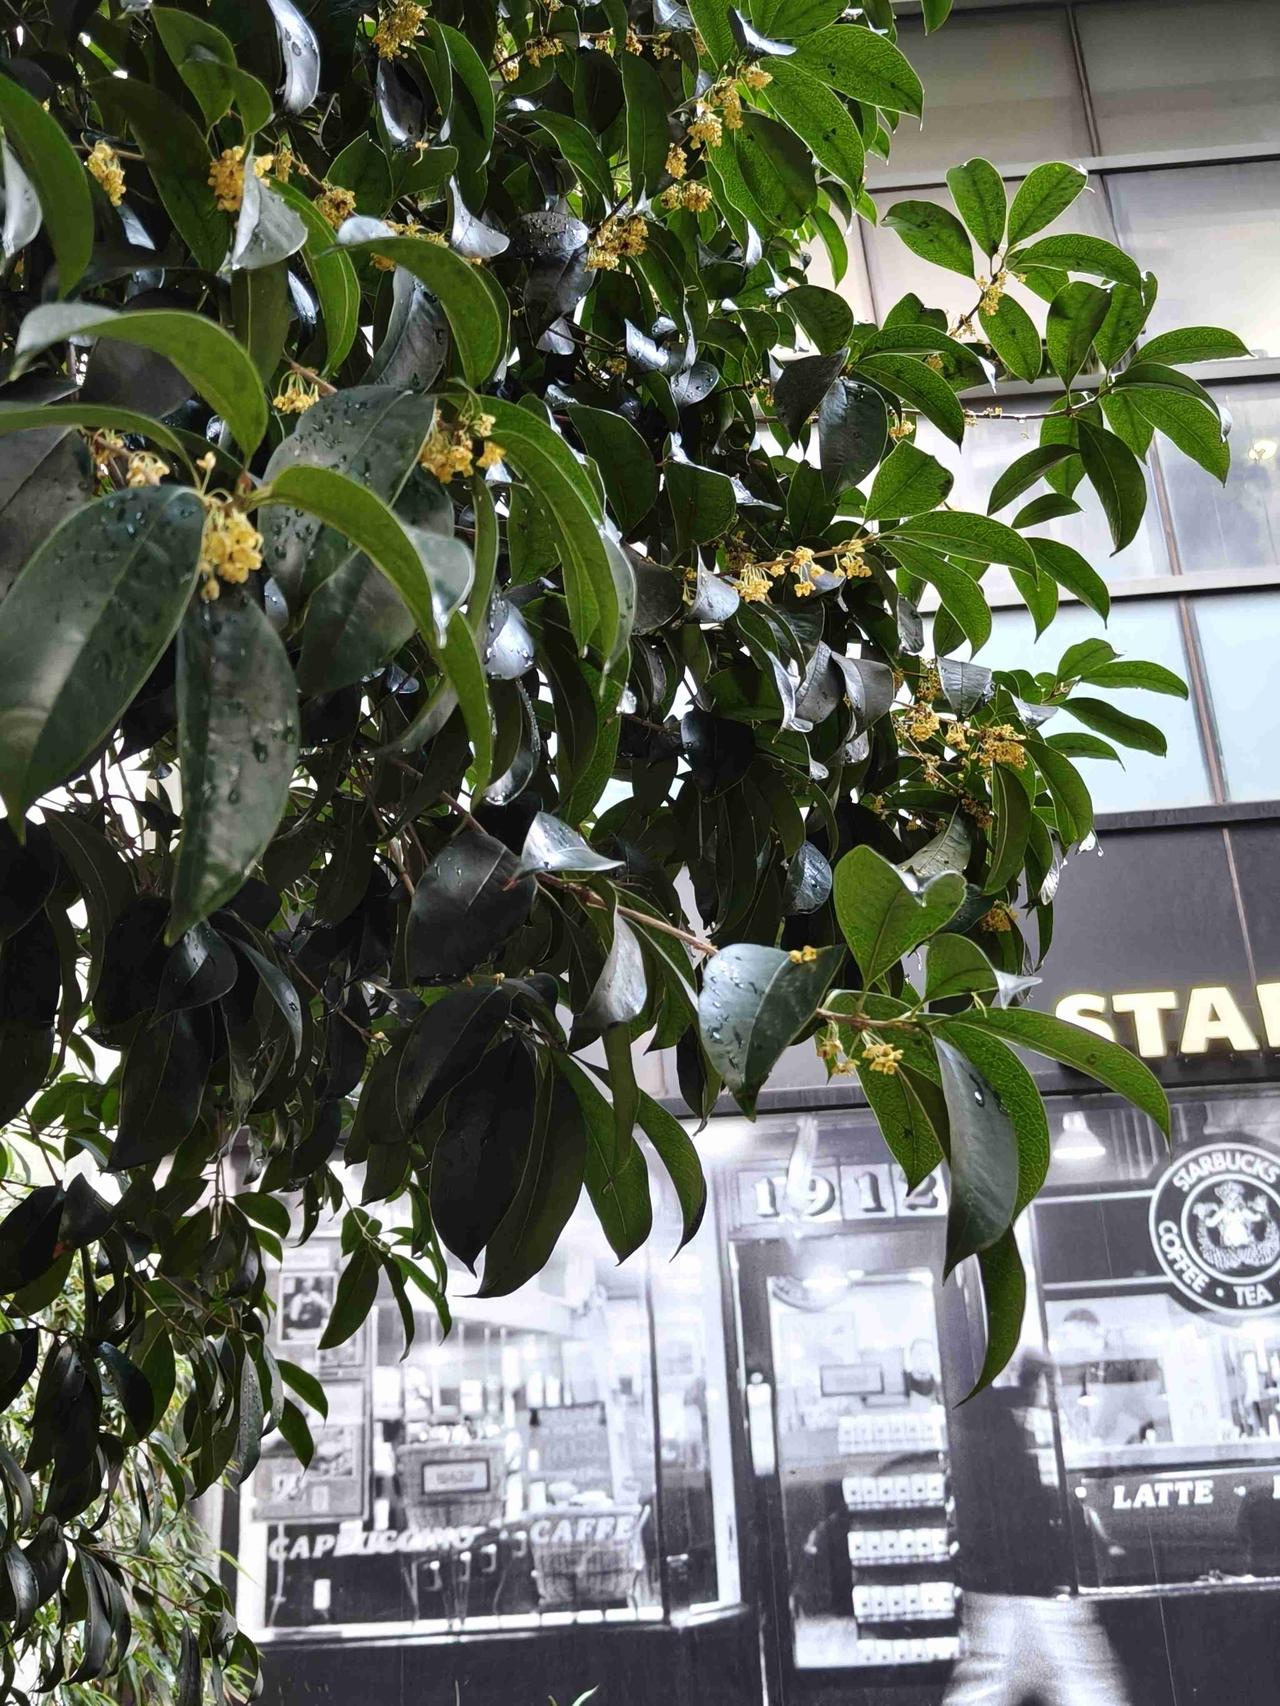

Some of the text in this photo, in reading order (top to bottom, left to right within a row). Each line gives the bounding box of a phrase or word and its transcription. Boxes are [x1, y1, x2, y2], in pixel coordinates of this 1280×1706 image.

[1172, 1151, 1280, 1192] STARBUCKS
[754, 1172, 938, 1217] 1912
[1158, 1220, 1273, 1306] COFFEE TEA
[1113, 1480, 1214, 1509] LATTE
